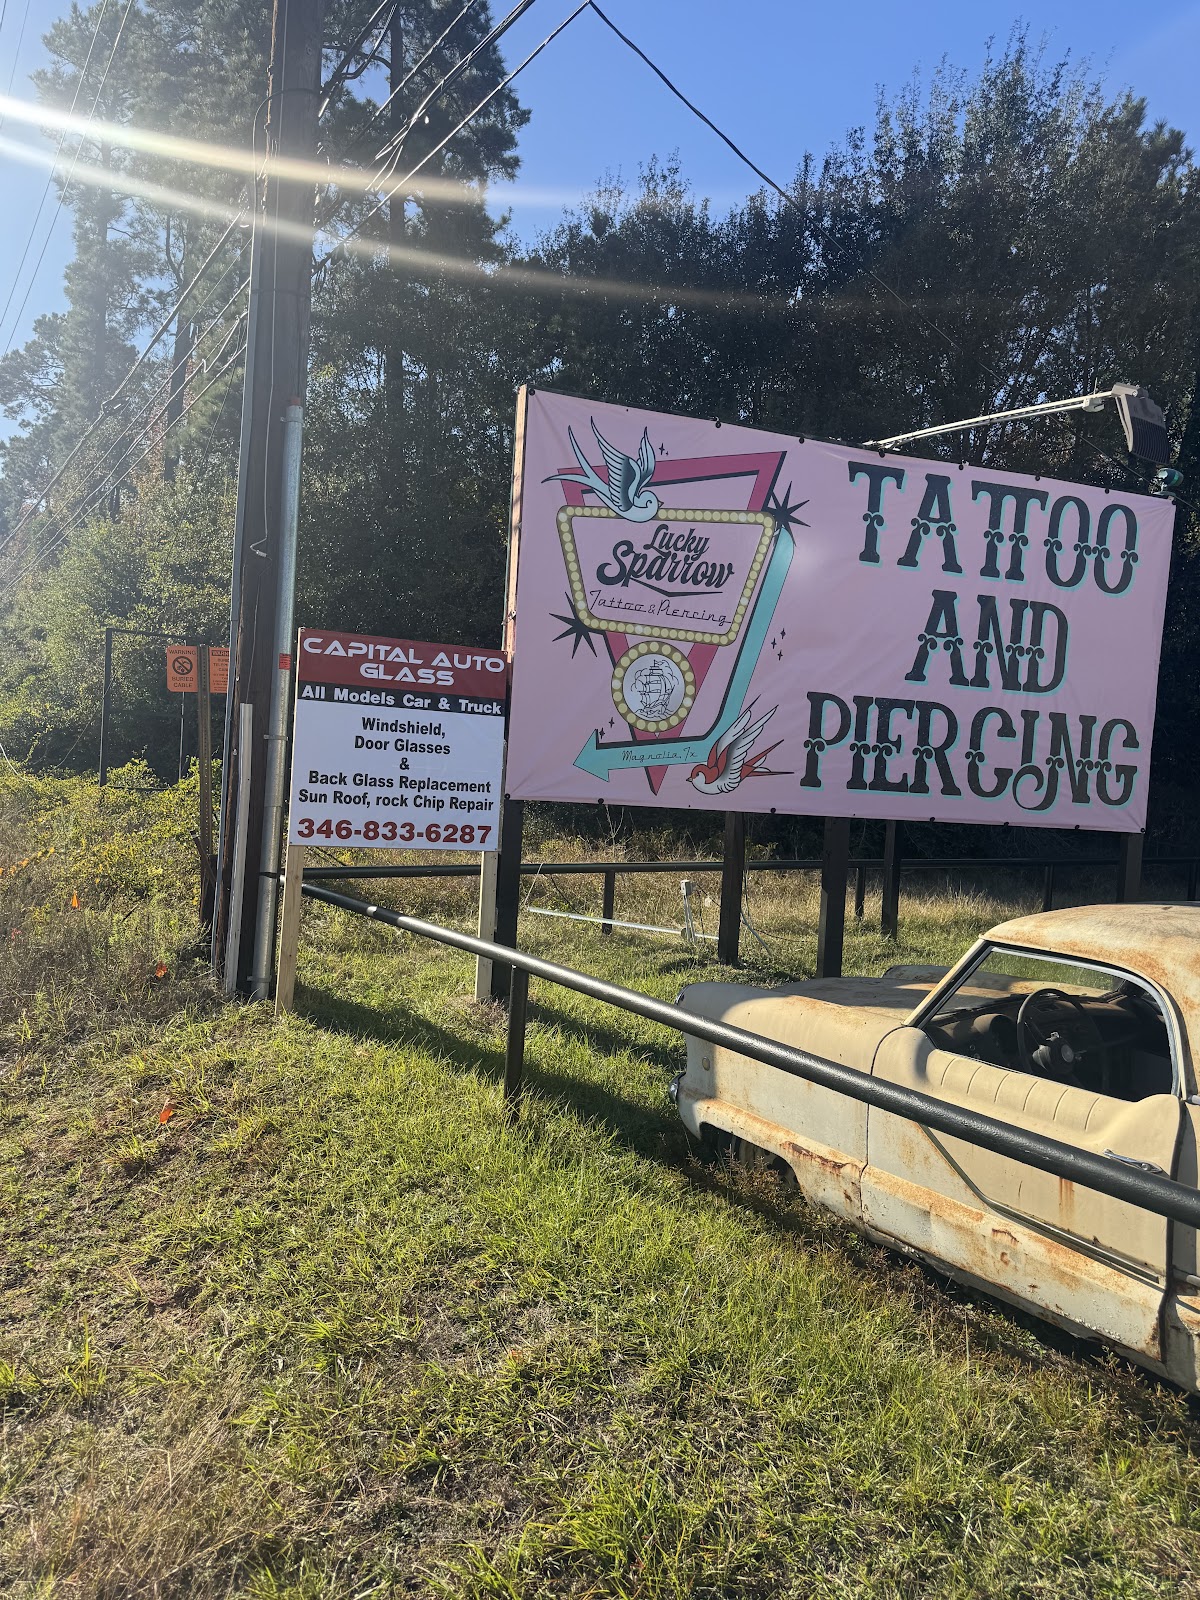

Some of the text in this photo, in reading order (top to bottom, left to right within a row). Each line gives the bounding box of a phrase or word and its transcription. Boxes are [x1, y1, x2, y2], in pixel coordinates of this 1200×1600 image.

[643, 523, 711, 561] Lucky
[848, 461, 1139, 596] TATTOO
[596, 540, 735, 588] Sparrow
[589, 590, 647, 612] Tattoo
[657, 599, 732, 627] Piercing
[303, 637, 424, 665] CAPITAL
[431, 651, 505, 673] AUTO
[904, 589, 1070, 695] AND
[359, 663, 454, 686] GLASS
[301, 685, 502, 714] All Models Car & Truck
[361, 717, 446, 739] Windshield,
[354, 735, 451, 755] Door Glasses
[800, 691, 1140, 811] PIERCING
[399, 757, 410, 770] &
[308, 770, 491, 793] Back Glass Replacement
[299, 789, 494, 813] Sun Roof, rock Chip Repair
[297, 818, 492, 844] 346-833-6287
